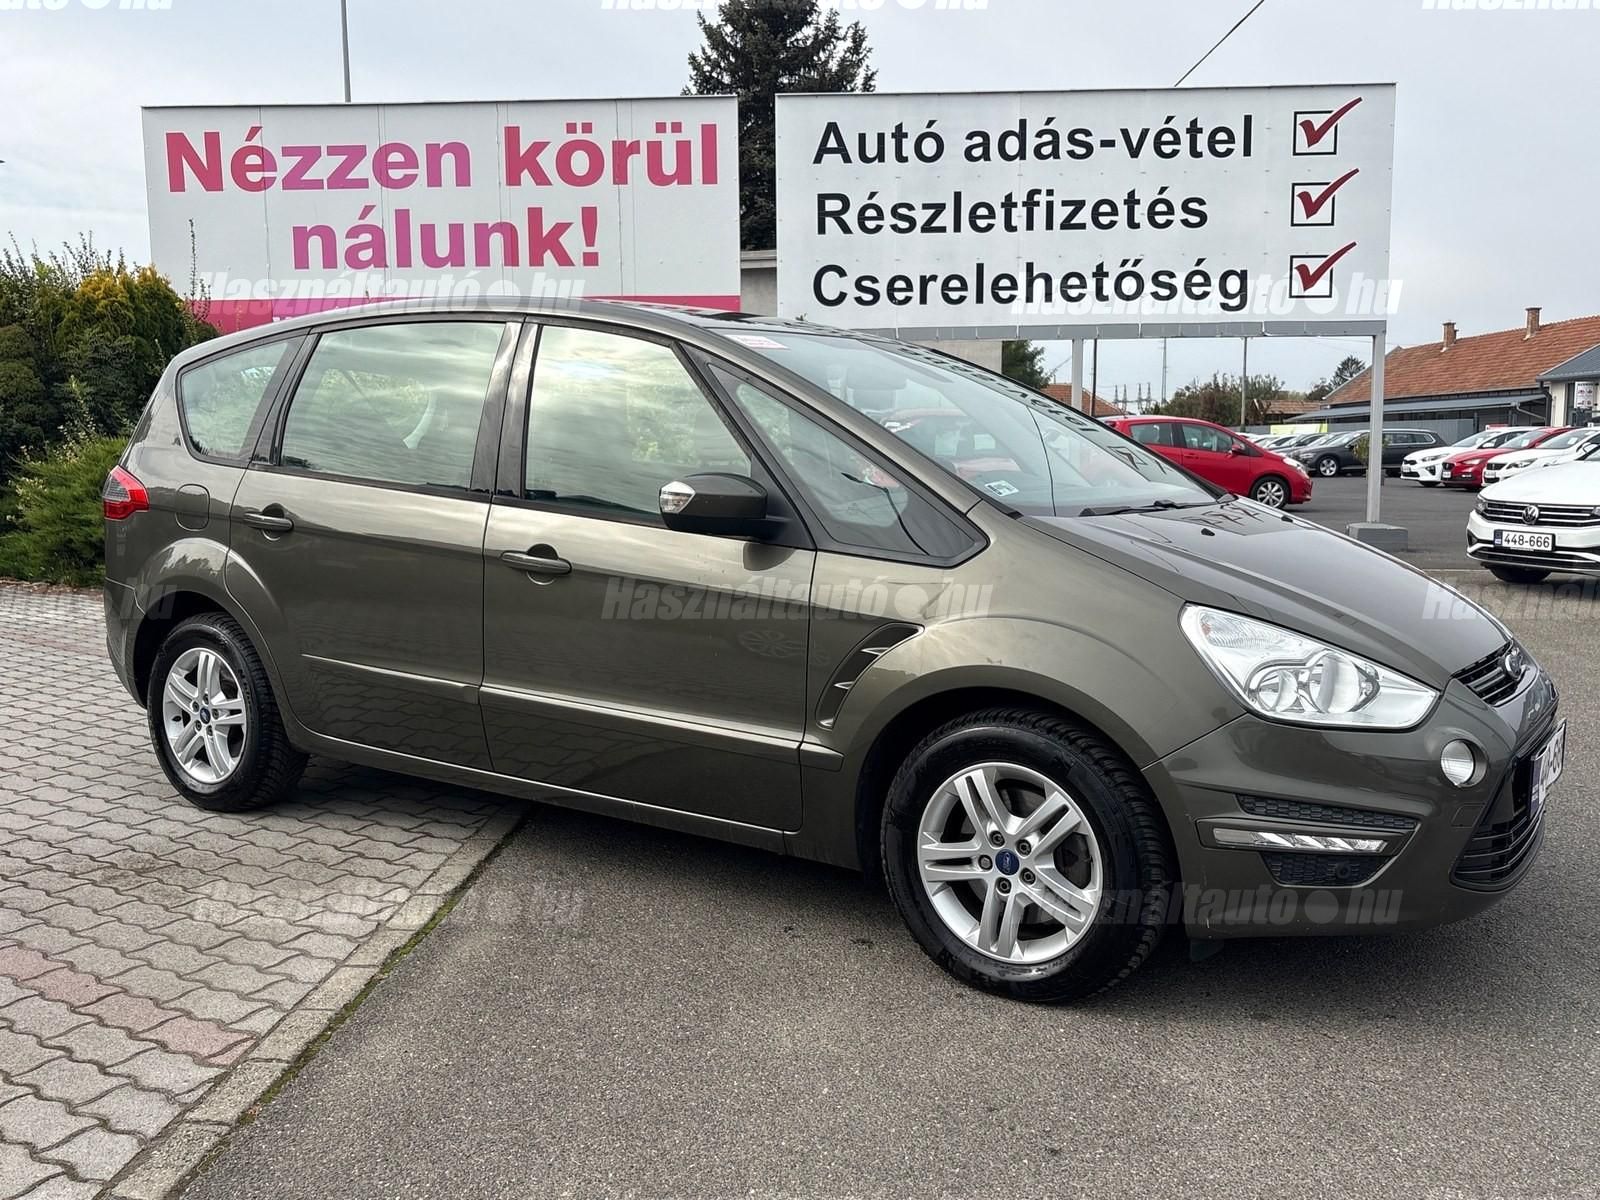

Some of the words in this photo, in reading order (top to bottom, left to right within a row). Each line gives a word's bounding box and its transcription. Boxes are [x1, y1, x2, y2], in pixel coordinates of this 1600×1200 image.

[167, 127, 471, 192] Nézzen
[505, 121, 718, 187] körül
[813, 119, 945, 165] Autó
[965, 114, 1253, 162] adás-vétel
[819, 187, 1208, 235] Részletfizetés
[293, 205, 599, 270] nálunk!
[813, 257, 1249, 311] Cserelehetőség
[1504, 533, 1550, 549] 448-666
